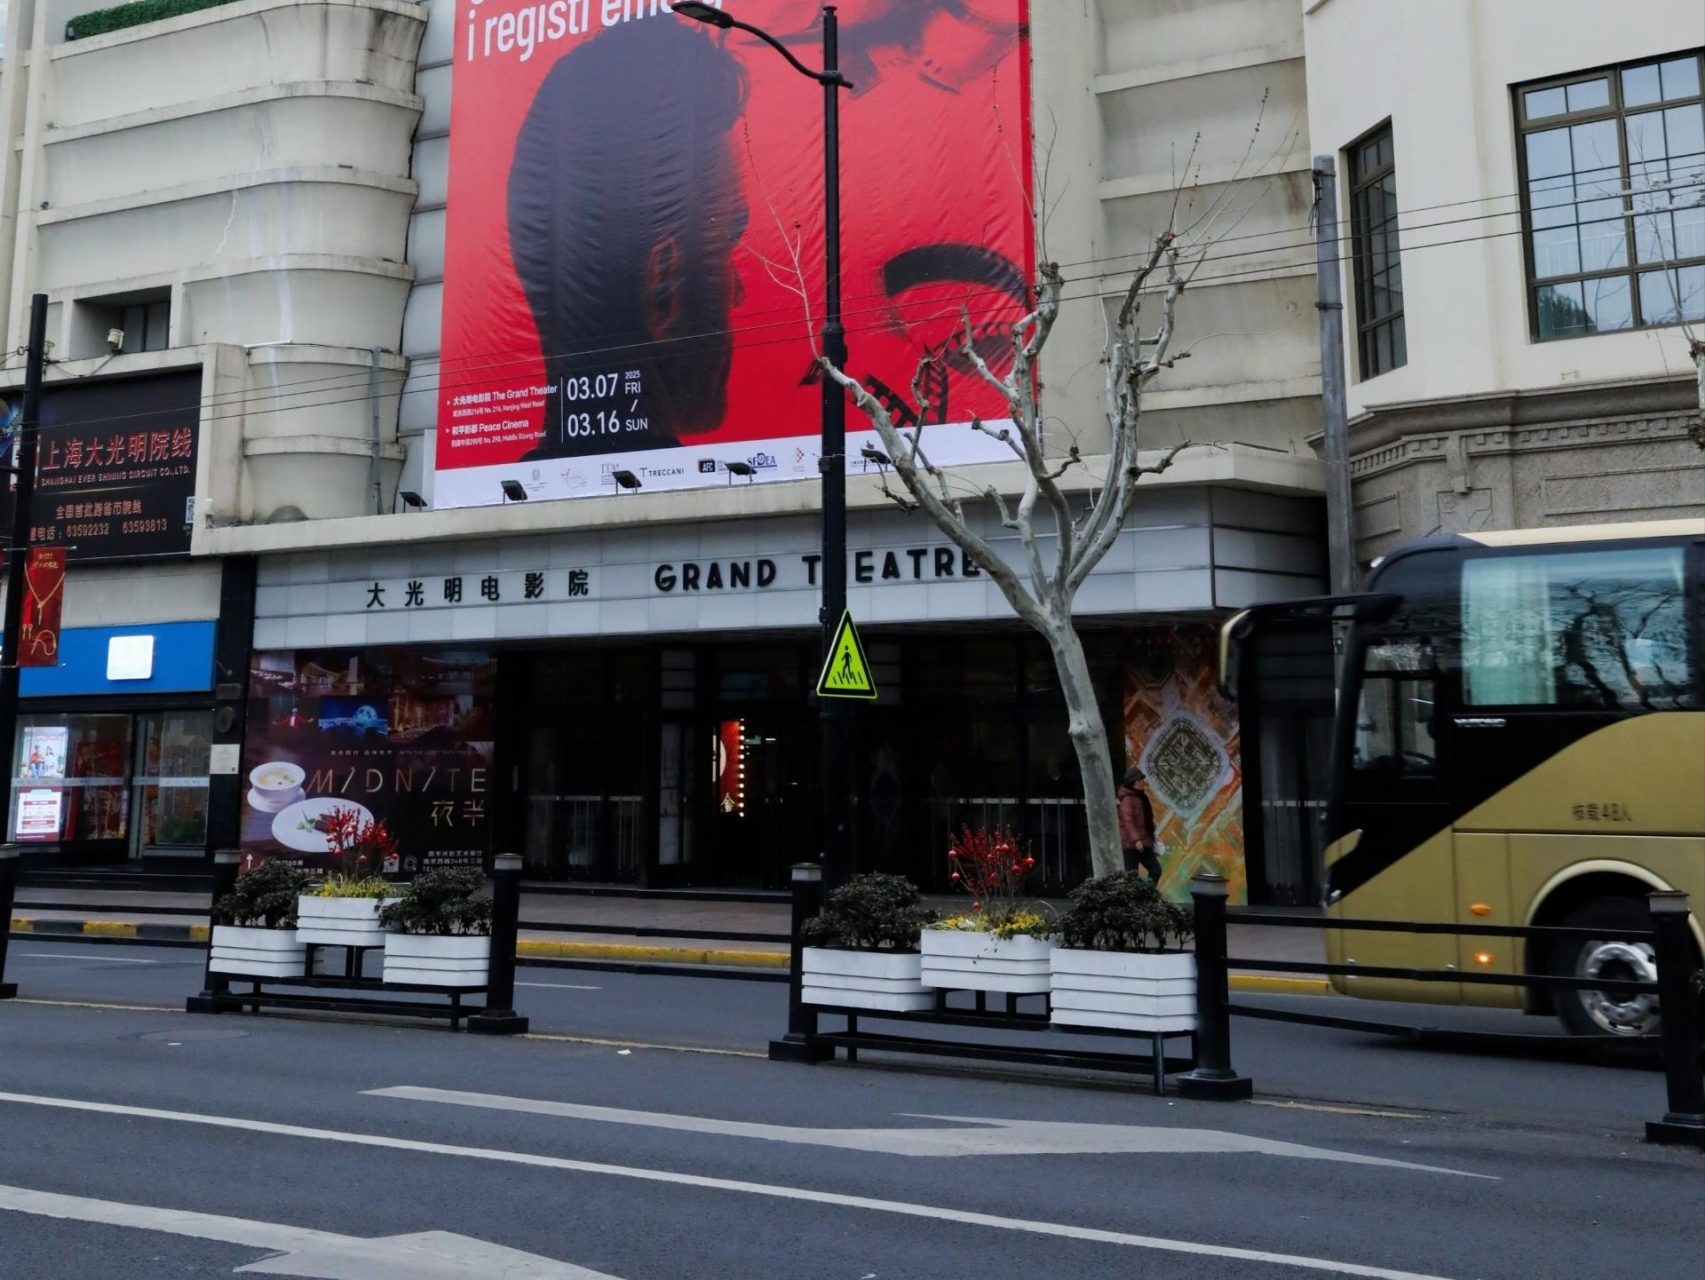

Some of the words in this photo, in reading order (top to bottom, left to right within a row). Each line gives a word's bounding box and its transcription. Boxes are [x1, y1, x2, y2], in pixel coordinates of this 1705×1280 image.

[467, 10, 476, 61] i
[567, 372, 619, 402] 03.07
[625, 381, 641, 395] FRI
[625, 370, 641, 379] 2025
[492, 391, 507, 401] The
[507, 388, 529, 400] Grand
[530, 384, 558, 397] Theater
[479, 422, 501, 434] Peace
[502, 419, 529, 430] Cinema
[567, 410, 620, 438] 03.16
[625, 418, 648, 432] SUN
[41, 427, 192, 470] 上海大光明院线
[41, 474, 76, 486] SHANGHAI
[78, 473, 96, 484] EVER
[129, 468, 157, 480] CIRCUIT
[648, 467, 685, 478] TRECCANI
[654, 557, 778, 593] GRAND
[801, 547, 982, 586] TEATRE
[365, 568, 589, 609] 大光明电影院
